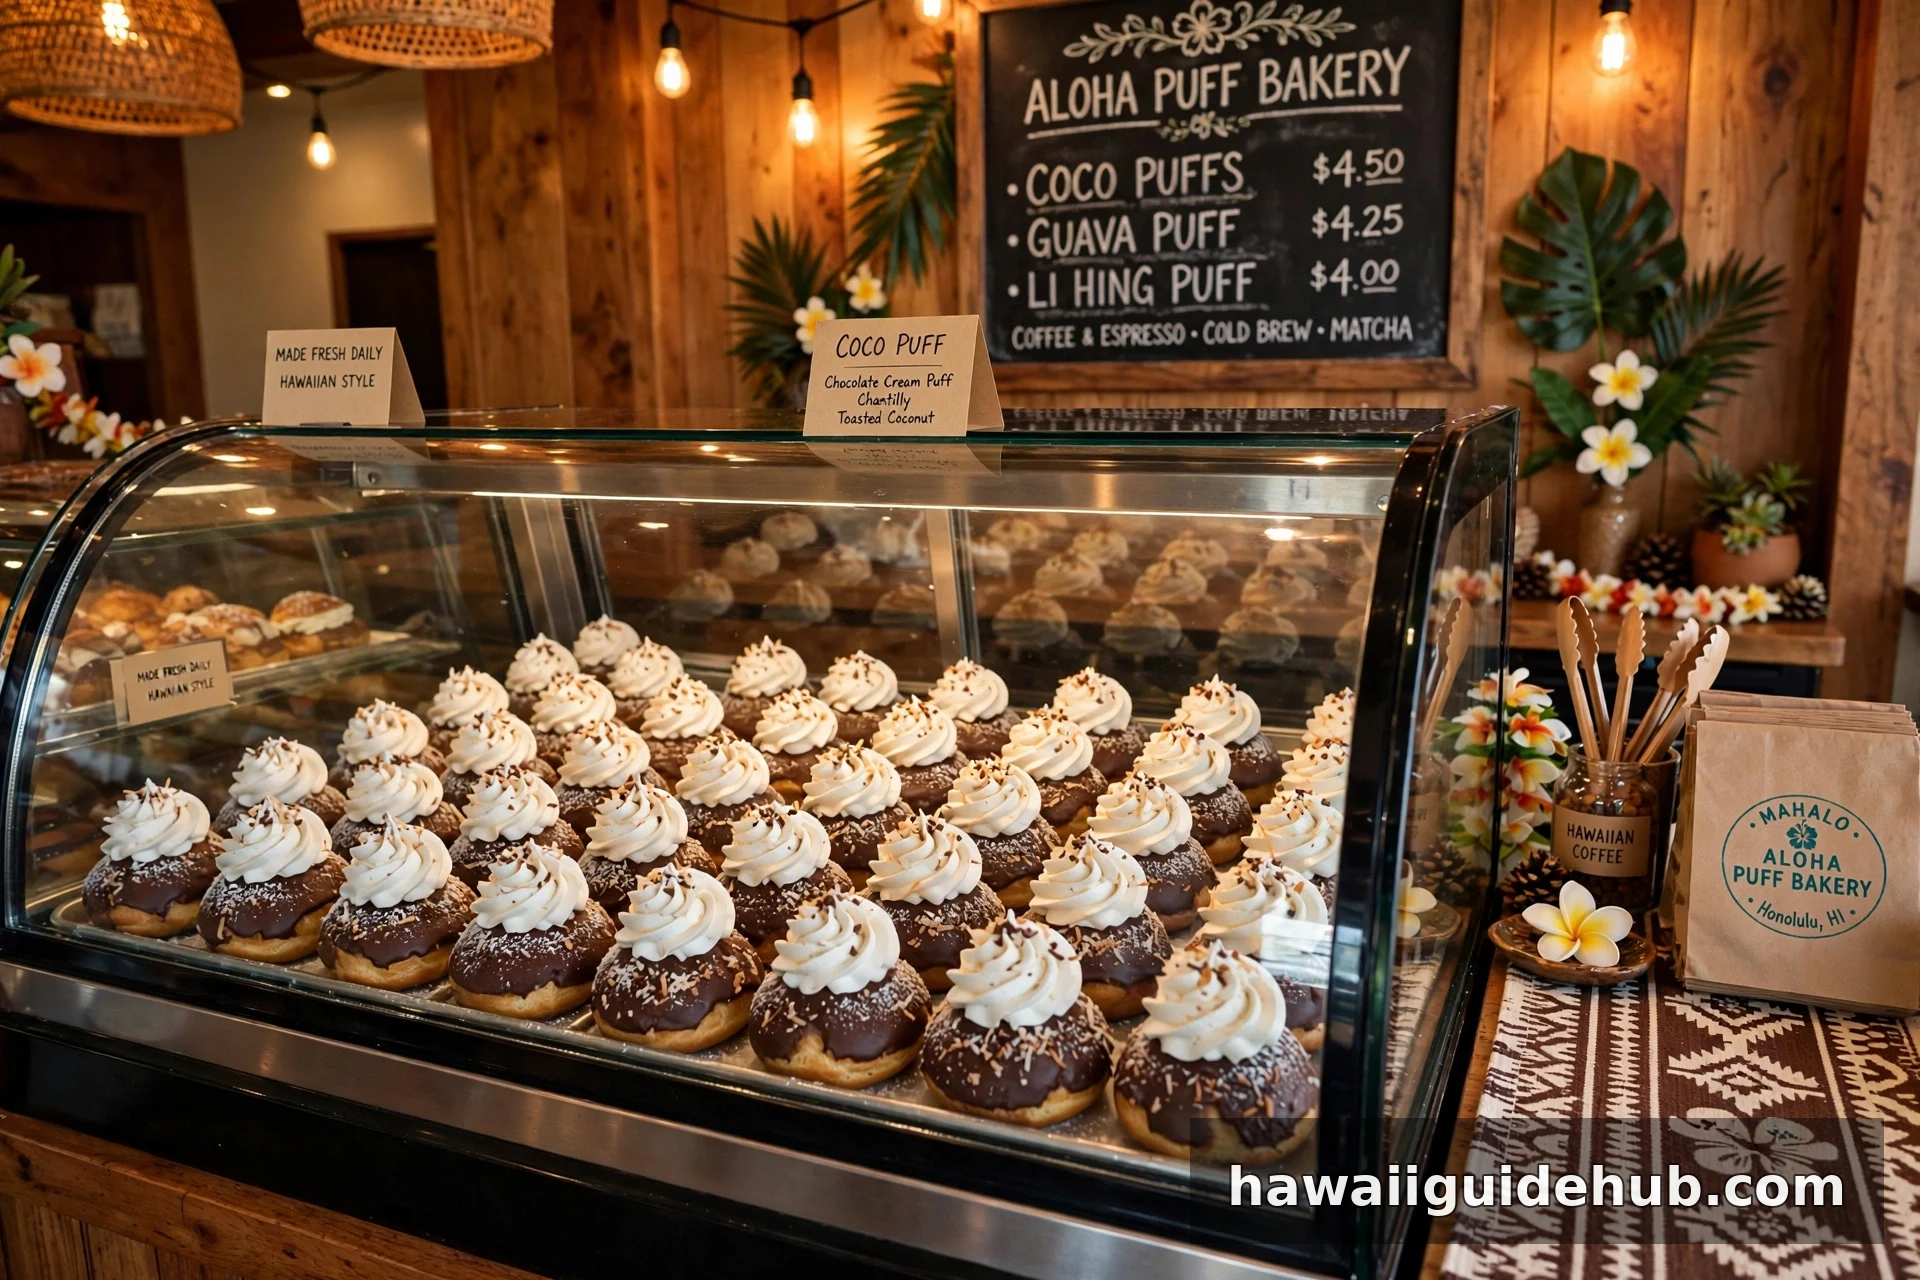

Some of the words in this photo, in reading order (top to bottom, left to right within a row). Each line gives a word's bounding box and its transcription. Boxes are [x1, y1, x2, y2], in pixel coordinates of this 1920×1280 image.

[1023, 71, 1138, 126] ALOHA
[1154, 62, 1242, 113] PUFF
[1259, 45, 1411, 104] BAKERY
[1026, 163, 1118, 207] COCO
[1135, 151, 1244, 199] PUFFS
[1312, 148, 1404, 188] $4.50
[1027, 216, 1136, 258] GUAVA
[1153, 209, 1241, 251] PUFF
[1312, 204, 1404, 243] $4.25
[1027, 270, 1057, 309] LI
[1074, 267, 1155, 307] HING
[1171, 262, 1257, 304] PUFF
[1310, 259, 1400, 296] $4.00
[1012, 325, 1076, 350] COFFEE
[1082, 328, 1094, 348] &
[1100, 322, 1186, 348] ESPRESSO
[1202, 319, 1251, 344] COLD
[1256, 318, 1312, 343] BREW
[1330, 316, 1414, 342] MATCHA
[276, 347, 308, 362] MADE
[311, 346, 346, 361] FRESH
[351, 346, 383, 360] DAILY
[836, 334, 886, 359] COCO
[896, 333, 947, 356] PUFF
[280, 374, 337, 389] HAWAIIAN
[341, 373, 376, 388] STYLE
[824, 375, 879, 389] Chocolate
[883, 374, 920, 387] Cream
[926, 373, 955, 388] Puff
[857, 392, 911, 411] Chantilly
[837, 410, 882, 425] Toasted
[887, 410, 936, 424] Coconut
[191, 677, 214, 692] STYLE
[1758, 802, 1850, 831] MAHALO
[1567, 822, 1635, 845] HAWAIIAN
[1572, 843, 1624, 865] COFFEE
[1763, 848, 1841, 872] ALOHA
[1733, 865, 1783, 889] PUFF
[1791, 872, 1872, 898] BAKERY
[1756, 900, 1824, 932] Honolulu,
[1825, 908, 1846, 926] HI
